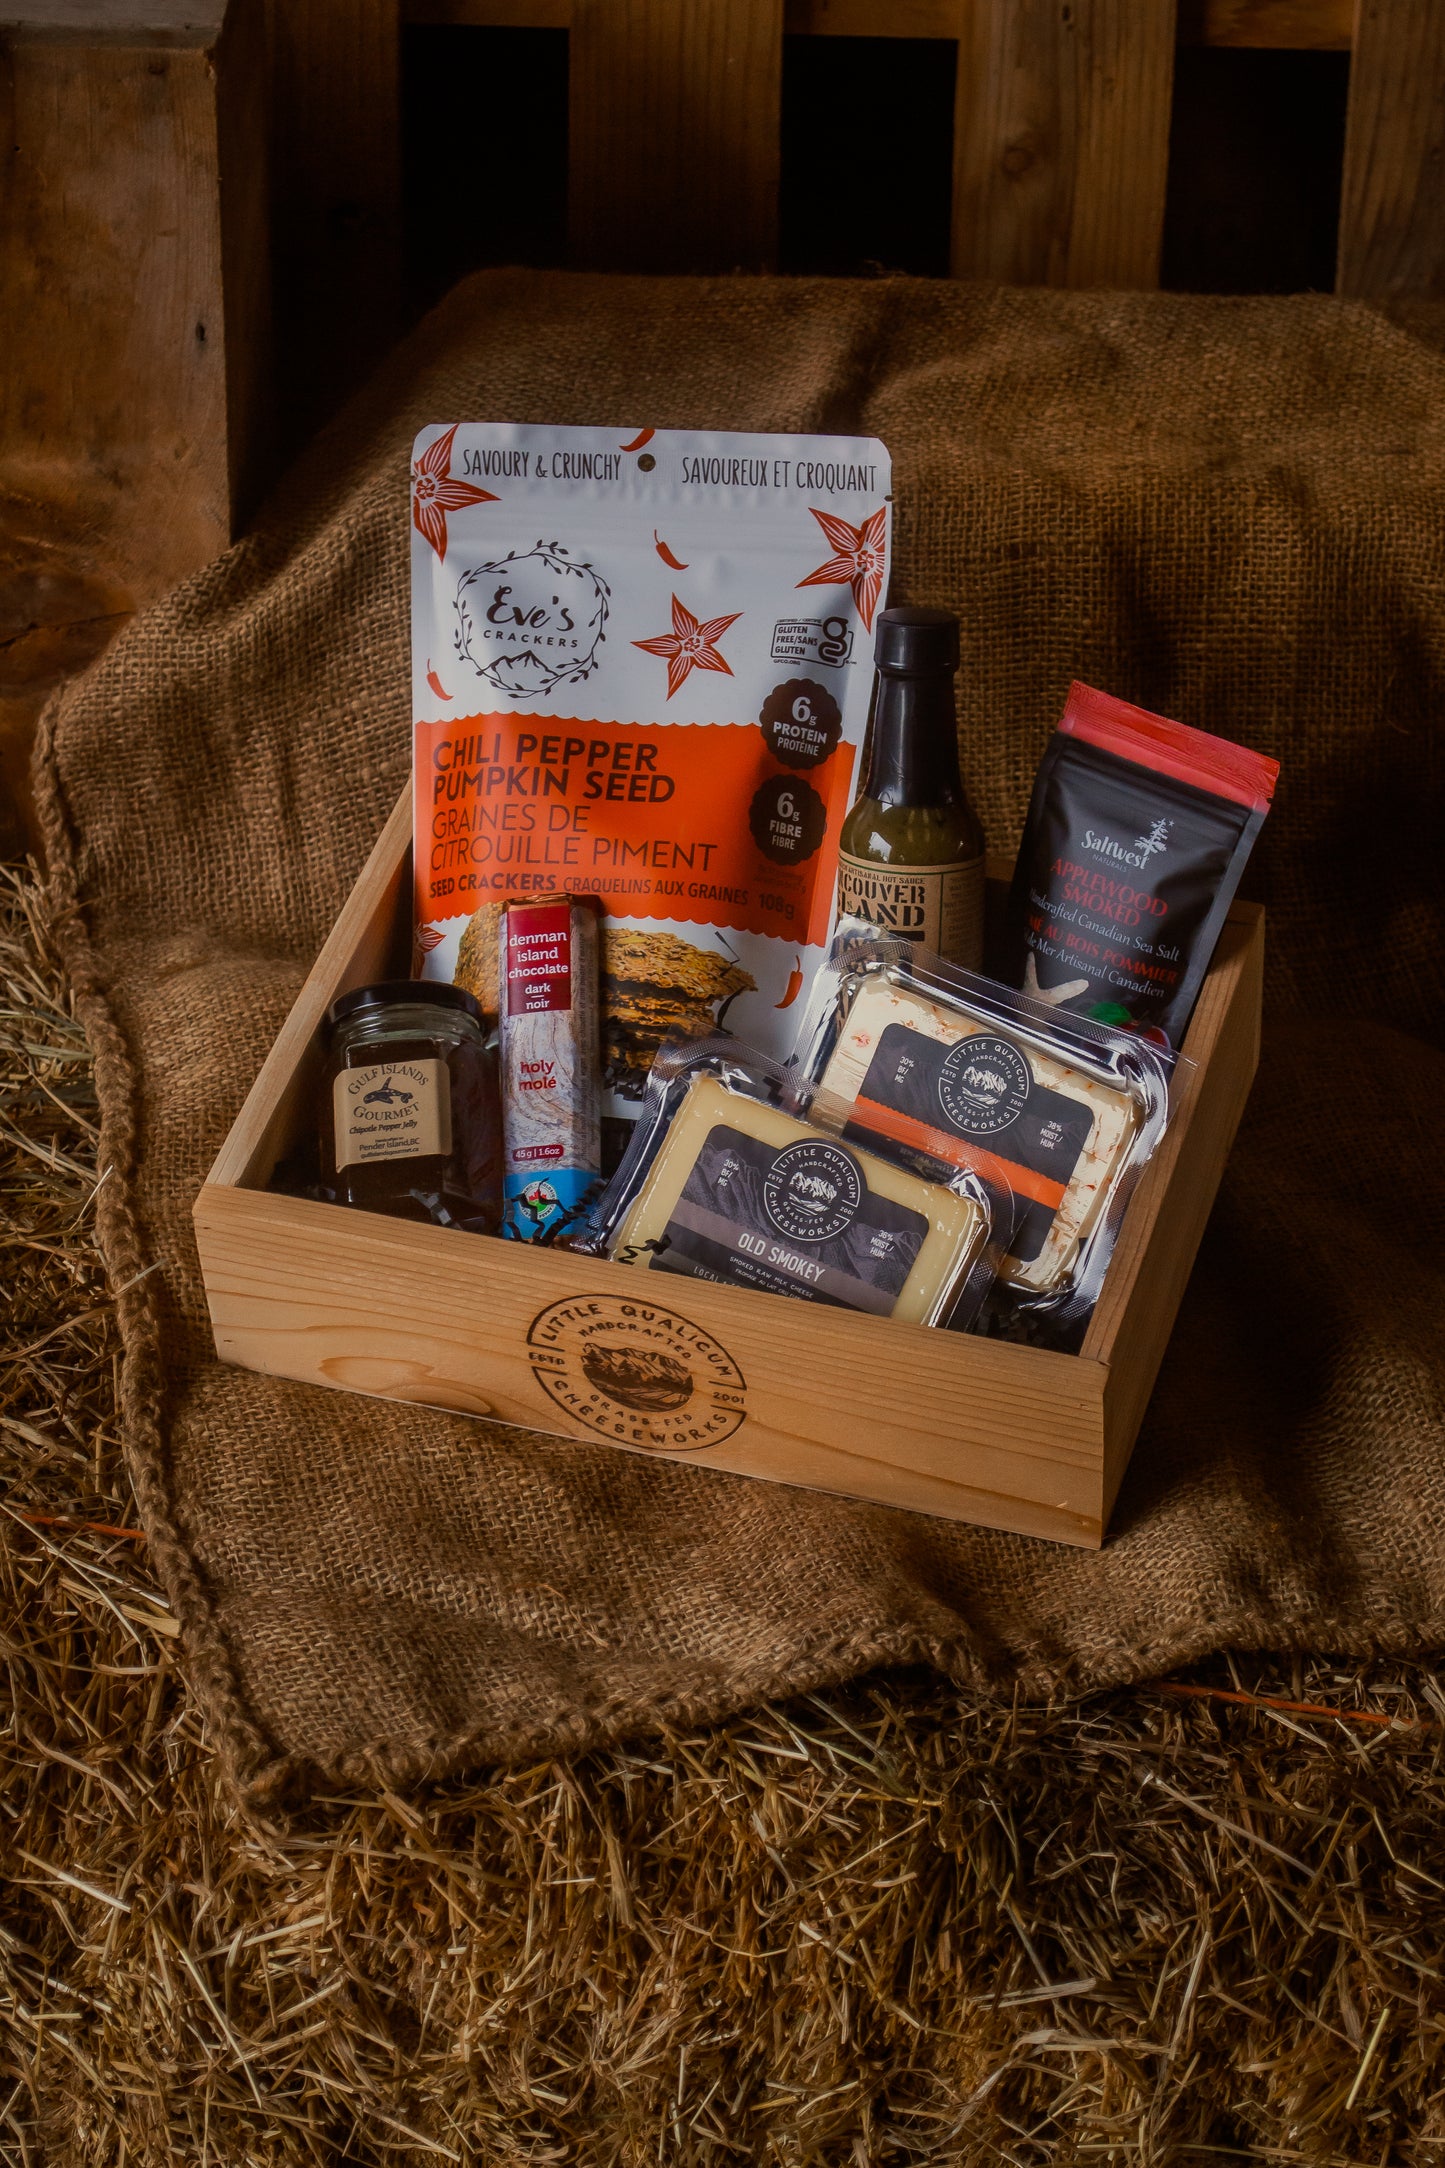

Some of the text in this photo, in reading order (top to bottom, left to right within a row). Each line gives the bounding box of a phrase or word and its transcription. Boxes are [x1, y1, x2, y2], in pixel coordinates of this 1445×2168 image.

[463, 449, 621, 480] SAVOURY & CRUNCHY
[682, 456, 877, 494] SAVOUREUX ET CROQUANT
[486, 585, 575, 631] Eve's
[483, 629, 578, 648] CRACKERS
[778, 626, 808, 634] GLUTEN
[775, 645, 806, 656] GLUTEN
[776, 635, 818, 646] FREE/SANS
[772, 721, 828, 744] PROTEIN
[433, 733, 659, 772] CHILI PEPPER
[777, 736, 819, 757] PROTÉINE
[433, 766, 675, 805] PUMPKIN SEED
[432, 803, 592, 840] GRAINES DE
[769, 819, 802, 838] FIBRE
[771, 834, 796, 850] FIBRE
[1081, 830, 1150, 870] Saltwest
[430, 835, 718, 872] CITROUILLE PIMENT
[1092, 853, 1128, 873] NATURALS
[883, 875, 897, 883] HOT
[899, 877, 926, 885] SAUCE
[1050, 858, 1169, 917] APPLEWOOD
[429, 872, 795, 920] SEED CRACKERS CRAQUELINS AUX GRAINES 108g
[1060, 882, 1141, 927] SMOKED
[837, 891, 926, 928] LAND
[509, 931, 567, 947] denman
[1078, 912, 1131, 946] Canadian
[1133, 937, 1154, 954] Sea
[1155, 943, 1181, 962] Salt
[517, 947, 559, 963] island
[1043, 924, 1064, 942] AU
[1065, 932, 1100, 958] BOIS
[1102, 946, 1180, 985] POMMIER
[508, 963, 569, 979] chocolate
[1036, 938, 1057, 956] Mer
[1056, 949, 1107, 980] Artisanal
[1107, 969, 1166, 998] Canadien
[524, 983, 551, 995] dark
[525, 998, 550, 1010] noir
[520, 1059, 555, 1075] holy
[897, 1065, 909, 1075] BF/
[900, 1056, 914, 1068] 30%
[952, 1042, 1025, 1091] LITTLE QUALICUM
[970, 1054, 1013, 1080] HANDCRAFTED
[347, 1063, 429, 1095] GULF ISLANDS
[894, 1073, 905, 1084] MG
[941, 1068, 957, 1078] ESTD
[518, 1075, 557, 1092] molé
[353, 1101, 420, 1121] GOURMET
[943, 1086, 1011, 1129] CHEESEWORKS
[956, 1095, 996, 1118] GRASS-FED
[1010, 1098, 1024, 1108] 2001
[349, 1119, 418, 1135] Chipotle Pepper Jelly
[1047, 1120, 1062, 1132] 38%
[359, 1142, 386, 1151] Pender
[538, 1148, 561, 1158] 1.6oz
[721, 1168, 733, 1178] BF/
[724, 1159, 739, 1171] 30%
[780, 1148, 856, 1199] LITTLE QUALICUM
[798, 1161, 843, 1187] HANDCRAFTED
[718, 1177, 729, 1187] MG
[767, 1173, 783, 1184] ESTD
[769, 1191, 840, 1236] CHEESEWORKS
[783, 1201, 824, 1224] GRASS-FED
[840, 1206, 854, 1216] 2001
[878, 1229, 894, 1242] 36%
[738, 1232, 826, 1282] OLD SMOKEY
[693, 1266, 719, 1283] LOCAL
[729, 1256, 814, 1298] SMOKED RAW MILK CHEESE
[735, 1268, 757, 1281] FROMAGE
[767, 1283, 777, 1291] LAIT
[540, 1303, 733, 1377] LITTLE QUALICUM
[577, 1320, 692, 1360] HANDCRAFTED
[528, 1351, 566, 1366] ESTD
[713, 1391, 745, 1405] 2001
[554, 1379, 728, 1444] CHEESEWORKS
[590, 1394, 693, 1426] GRASS-FED
